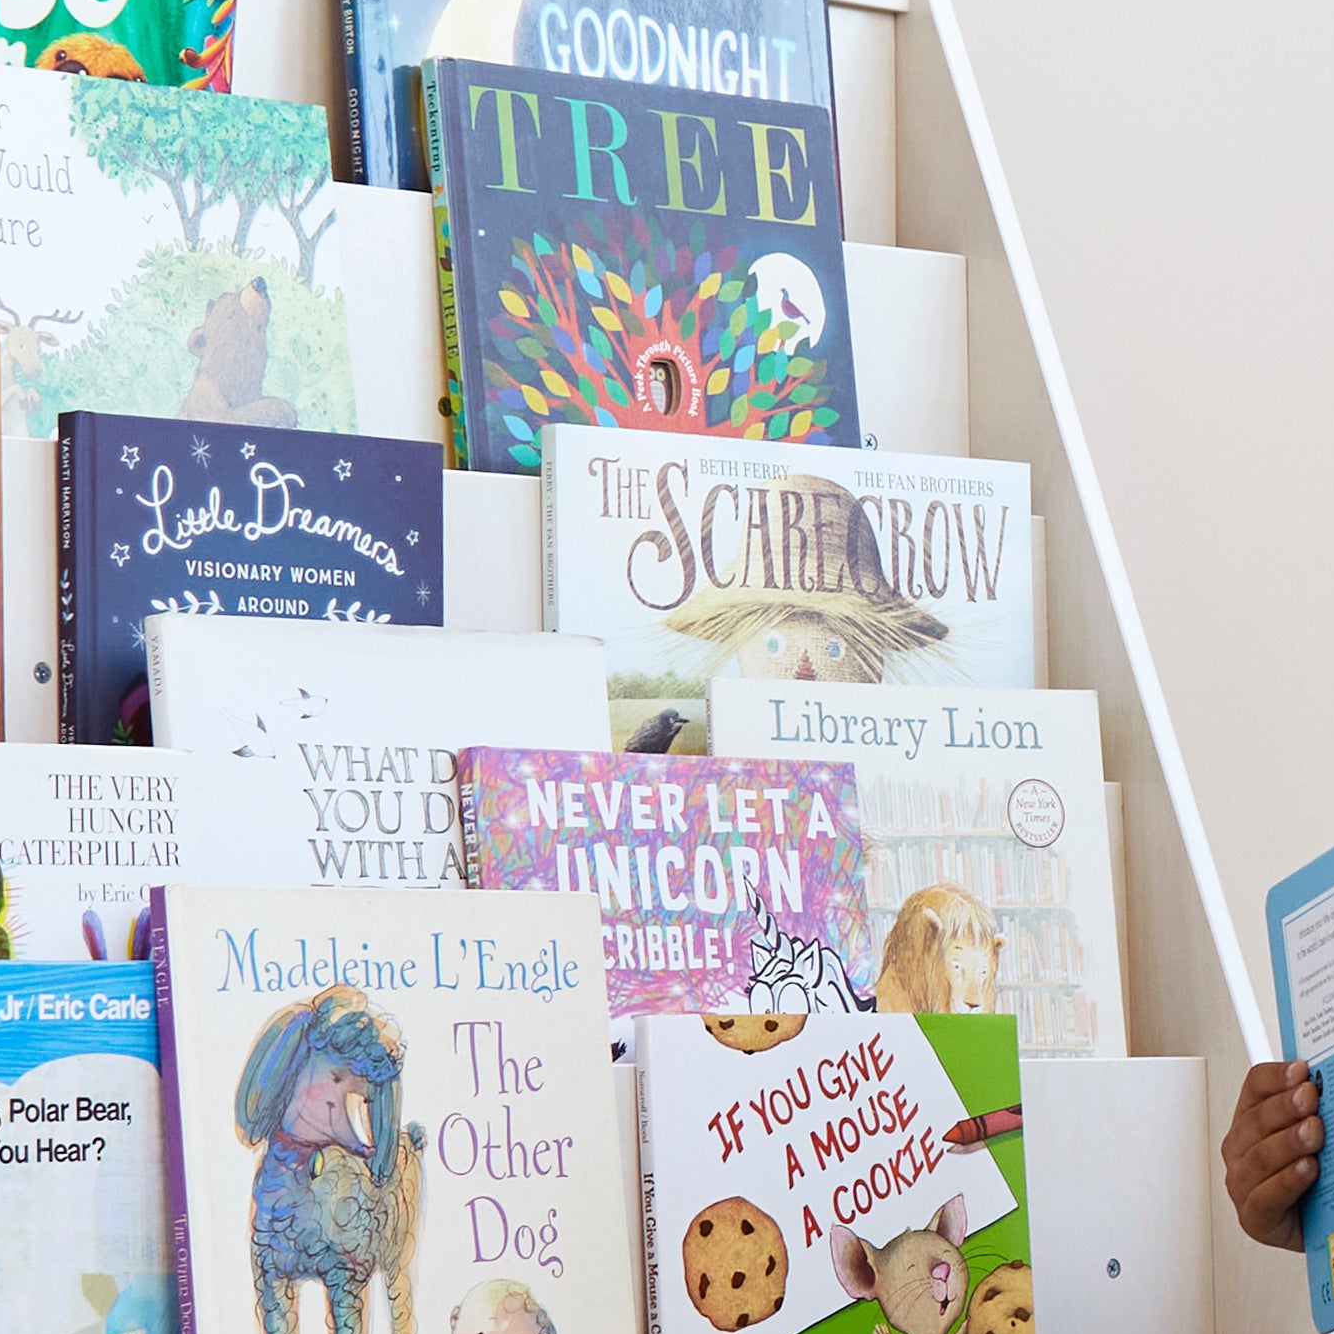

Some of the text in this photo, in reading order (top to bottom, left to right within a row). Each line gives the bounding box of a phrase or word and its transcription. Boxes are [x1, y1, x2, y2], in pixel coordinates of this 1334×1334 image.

[343, 8, 355, 55] BURTON
[538, 2, 797, 103] GOODNIGHT
[349, 87, 364, 176] GOODNIGHT
[425, 80, 442, 173] Teckentrup
[468, 84, 817, 227] TREE
[441, 283, 459, 359] TREE
[673, 344, 698, 384] Picture
[62, 438, 72, 549] VASHTI HARRISON
[700, 458, 791, 482] BETH FERRY
[854, 470, 995, 498] THE FAN BROTHERS
[136, 462, 405, 576] Little Dreamers
[587, 456, 1010, 612] THE SCARECROW
[185, 559, 356, 586] VISIONARY WOMEN
[237, 596, 310, 616] AROUND
[150, 635, 163, 697] YAMADA
[768, 699, 927, 760] Library
[942, 707, 1043, 750] Lion
[297, 743, 419, 784] WHAT
[48, 774, 179, 803] THE VERY
[303, 788, 404, 835] YOU
[526, 778, 837, 840] NEVER LET A
[1015, 797, 1056, 809] New York
[1030, 785, 1038, 795] A
[67, 807, 180, 835] HUNGRY
[460, 783, 481, 886] NEVER LET
[1024, 811, 1051, 823] Times
[307, 838, 468, 880] WITH A
[556, 842, 804, 914] UNICORN
[78, 883, 97, 909] by
[102, 883, 135, 903] Eric
[153, 927, 169, 1007] L'ENGLE
[215, 927, 580, 1003] Madeleine L'Engle
[600, 924, 736, 975] CRIBBLE!
[89, 992, 151, 1021] Carle
[453, 1021, 545, 1097] The
[9, 1098, 70, 1123] Polar
[75, 1097, 133, 1126] Bear,
[708, 1032, 894, 1163] IF YOU GIVE
[36, 1136, 106, 1163] Hear?
[438, 1105, 573, 1181] Other
[785, 1084, 919, 1190] A MOUSE
[643, 1173, 654, 1185] If
[644, 1188, 655, 1213] You
[803, 1126, 945, 1248] A COOKIE
[174, 1213, 187, 1244] THE
[464, 1196, 564, 1278] Dog
[645, 1217, 657, 1249] Give
[648, 1263, 659, 1310] Mouse
